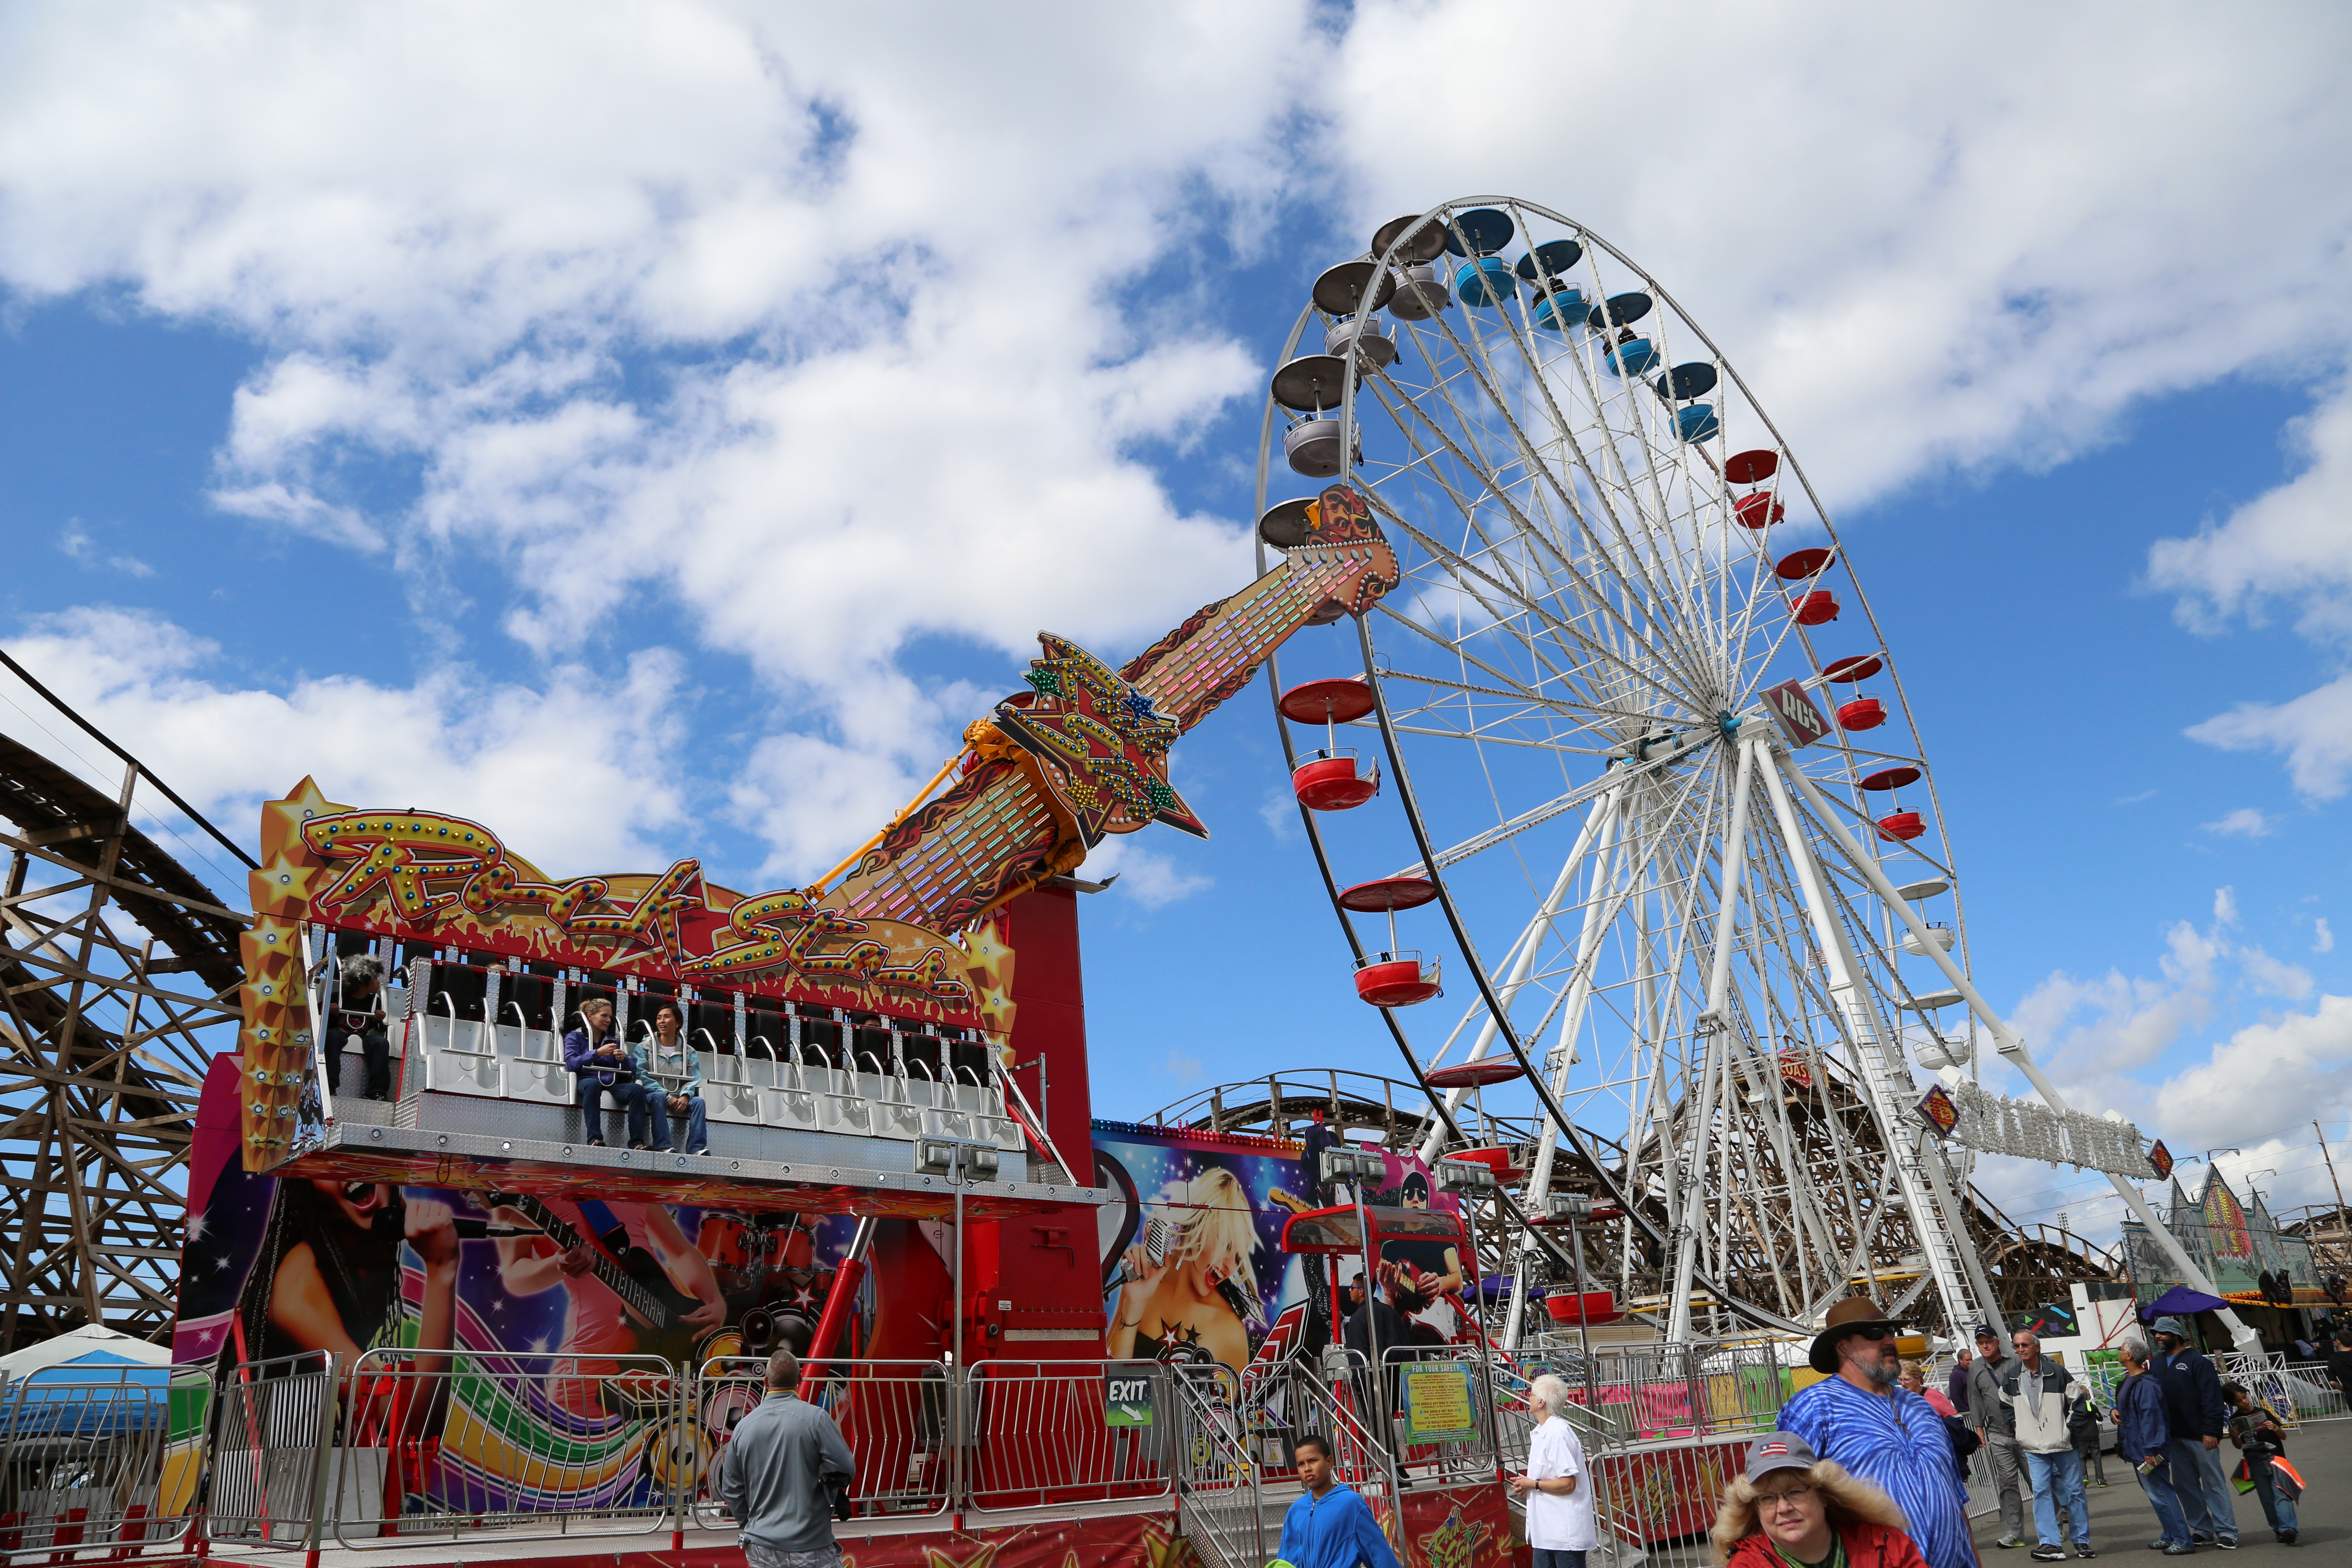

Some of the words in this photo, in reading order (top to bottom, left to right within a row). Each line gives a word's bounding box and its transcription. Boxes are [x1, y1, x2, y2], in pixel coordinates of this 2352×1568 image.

[1781, 687, 1821, 736] RCS
[301, 808, 704, 976] Rock
[677, 890, 969, 998] Star
[1109, 1380, 1147, 1401] EXIT
